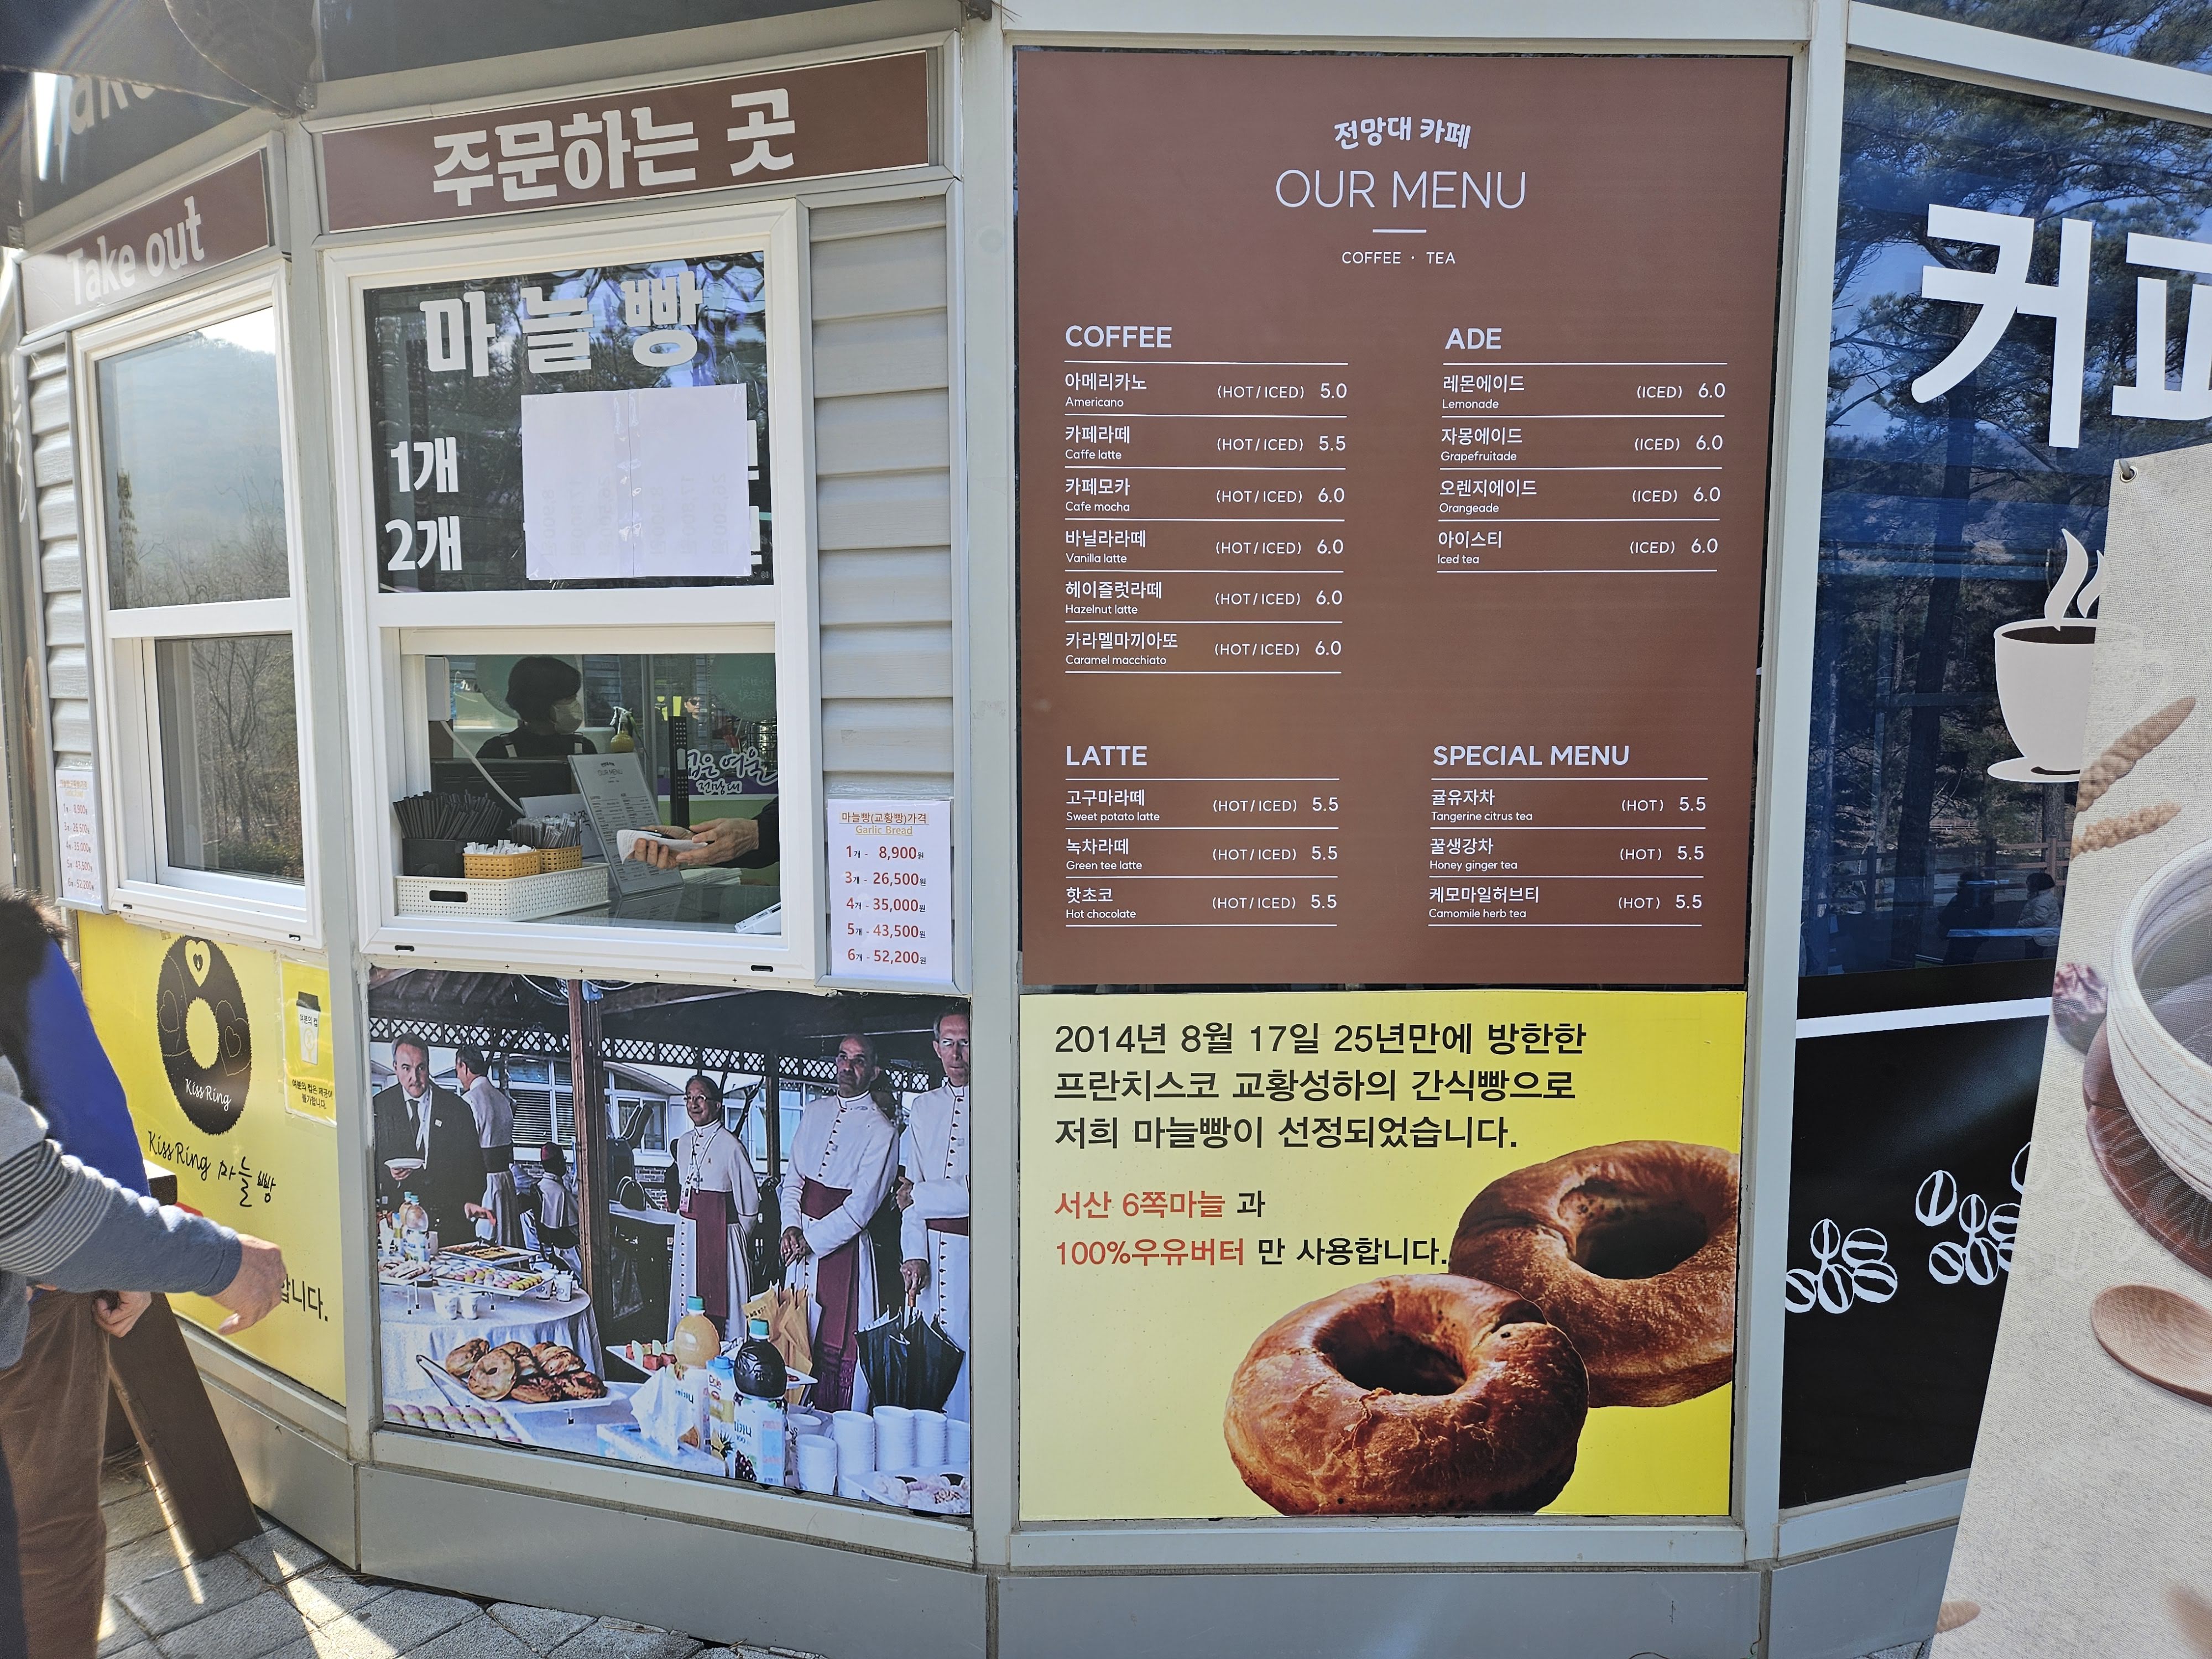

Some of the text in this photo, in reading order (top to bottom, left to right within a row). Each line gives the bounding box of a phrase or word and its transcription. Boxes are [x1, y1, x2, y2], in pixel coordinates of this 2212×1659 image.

[1334, 116, 1471, 150] 전망대 카페
[432, 88, 795, 207] 주문하는 곳
[1276, 169, 1526, 209] OUR MENU
[67, 196, 205, 305] Take out
[1342, 251, 1455, 264] COFFEE TEA
[420, 270, 703, 378] 마늘빵
[1065, 325, 1172, 348] COFFEE
[1445, 328, 1502, 349] ADE
[1065, 372, 1147, 391] 아메리카노
[1443, 374, 1525, 393] 레몬에이드
[1320, 383, 1347, 399] 5.0
[1637, 383, 1725, 399] (ICED) 6.0
[1065, 397, 1124, 407] Americano
[1442, 399, 1499, 409] Lemonade
[1065, 425, 1130, 444] 카페라떼
[1441, 427, 1522, 445] 자몽에이드
[1319, 435, 1345, 451] 5.5
[1635, 435, 1723, 451] (ICED) 6.0
[1065, 449, 1122, 460] Caffe latte
[1441, 451, 1517, 463] Grapefruitade
[390, 436, 459, 493] 1개
[1066, 477, 1130, 496] 카페모카
[1439, 479, 1537, 497] 오렌지에이드
[1318, 487, 1345, 503] 6.0
[1632, 487, 1720, 503] (ICED) 6.0
[1066, 501, 1130, 512] Cafe mocha
[1439, 503, 1499, 515] Orangeade
[385, 515, 462, 571] 2개
[1066, 529, 1146, 547] 바닐라라떼
[1438, 530, 1502, 549] 아이스티
[1630, 538, 1718, 554] (ICED) 6.0
[1317, 539, 1344, 554] 6.0
[1066, 552, 1127, 563] Vanilla latte
[1437, 554, 1479, 564] Iced tea
[1065, 581, 1162, 599] 헤이즐럿라떼
[1316, 590, 1343, 605] 6.0
[1066, 604, 1138, 614] Hazelnut latte
[1066, 632, 1178, 650] 카라멜마끼아또
[1315, 640, 1342, 655] 6.0
[1066, 654, 1167, 665] Caramel macchiato
[1067, 745, 1147, 766] LATTE
[1433, 745, 1629, 765] SPECIAL MENU
[1066, 789, 1145, 806] 고구마라떼
[1312, 797, 1338, 812] 5.5
[1431, 789, 1495, 806] 귤유자차
[1621, 796, 1706, 812] (HOT) 5.5
[842, 812, 926, 825] 마늘빵(교황빵)가격
[1066, 811, 1160, 823] Sweet potato latte
[1431, 811, 1533, 823] Tangerine citrus tea
[855, 826, 912, 834] Garlic Bread
[846, 846, 924, 860] 1개 8,900원
[1066, 838, 1129, 855] 녹차라떼
[1312, 846, 1338, 860] 5.5
[1430, 838, 1494, 854] 꿀생강차
[1620, 846, 1704, 860] (HOT) 5.5
[1066, 860, 1142, 870] Green tee latte
[1430, 860, 1517, 872] Honey ginger tea
[845, 872, 926, 886] 3개 26,500원
[1066, 886, 1113, 904] 핫초코
[1311, 894, 1337, 909] 5.5
[1429, 886, 1538, 903] 케모마일허브티
[1619, 894, 1702, 909] (HOT) 5.5
[846, 898, 926, 912] 4개 35,000원
[1428, 908, 1526, 918] Camomile herb tea
[1066, 909, 1136, 919] Hot chocolate
[847, 923, 926, 938] 5개 43,500원
[848, 949, 926, 964] 6개 52,200원
[1055, 1022, 1587, 1055] 2014년 8월 17일 25년만에 방한한
[292, 1079, 306, 1091] 여분의
[1054, 1069, 1575, 1102] 프란치스코 교황성하의 간식빵으로
[1055, 1117, 1517, 1149] 저희 마늘빵이 선정되었습니다.
[218, 1156, 276, 1207] 마늘빵
[1054, 1190, 1266, 1219] 서산 6쪽마늘 과
[1057, 1237, 1447, 1266] 100%우유버터 만 사용합니다.
